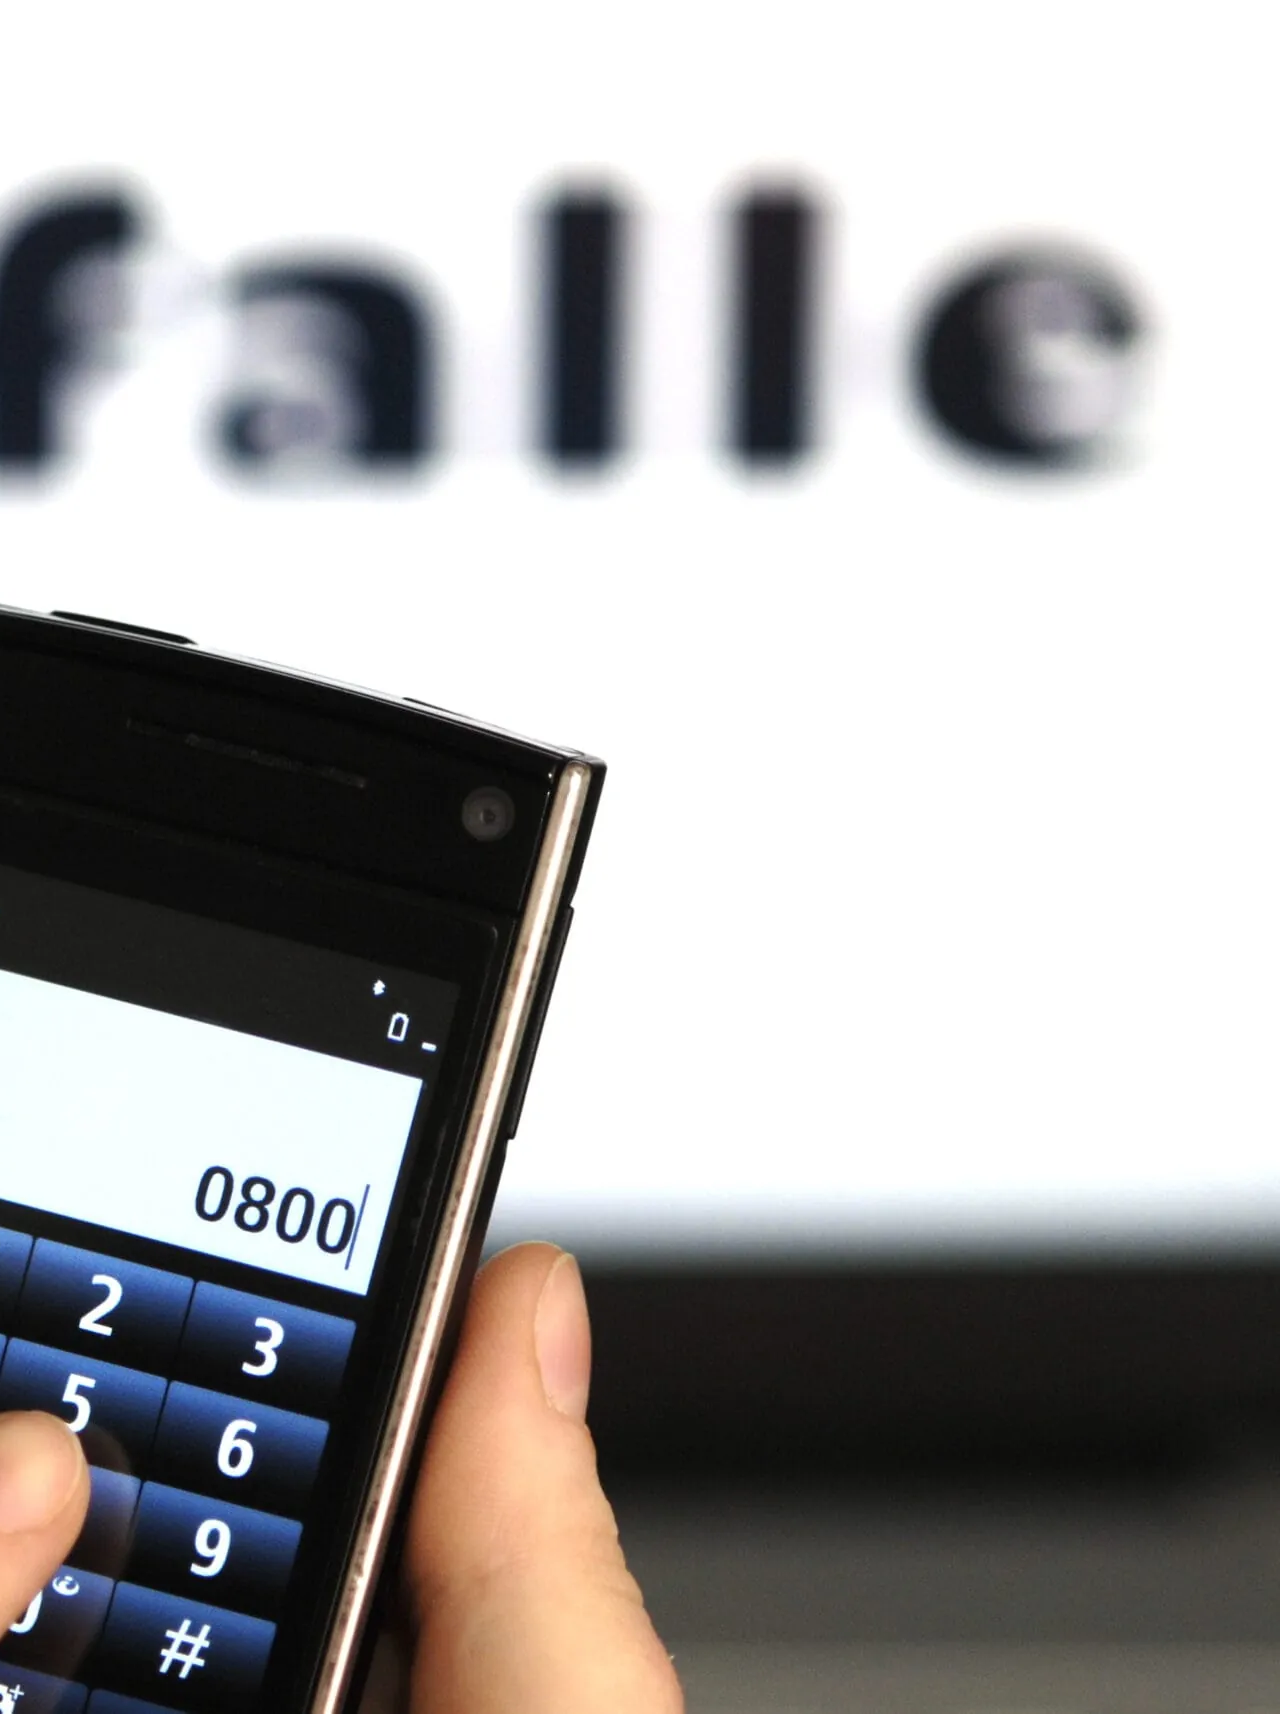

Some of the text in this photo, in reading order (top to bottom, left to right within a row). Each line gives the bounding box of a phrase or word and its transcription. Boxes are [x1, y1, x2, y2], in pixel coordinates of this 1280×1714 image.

[195, 1165, 356, 1254] 0800
[78, 1274, 123, 1336] 2
[241, 1316, 284, 1376] 3
[62, 1373, 97, 1433] 5
[217, 1418, 257, 1477] 6
[190, 1519, 231, 1577] 9
[159, 1619, 211, 1679] #
